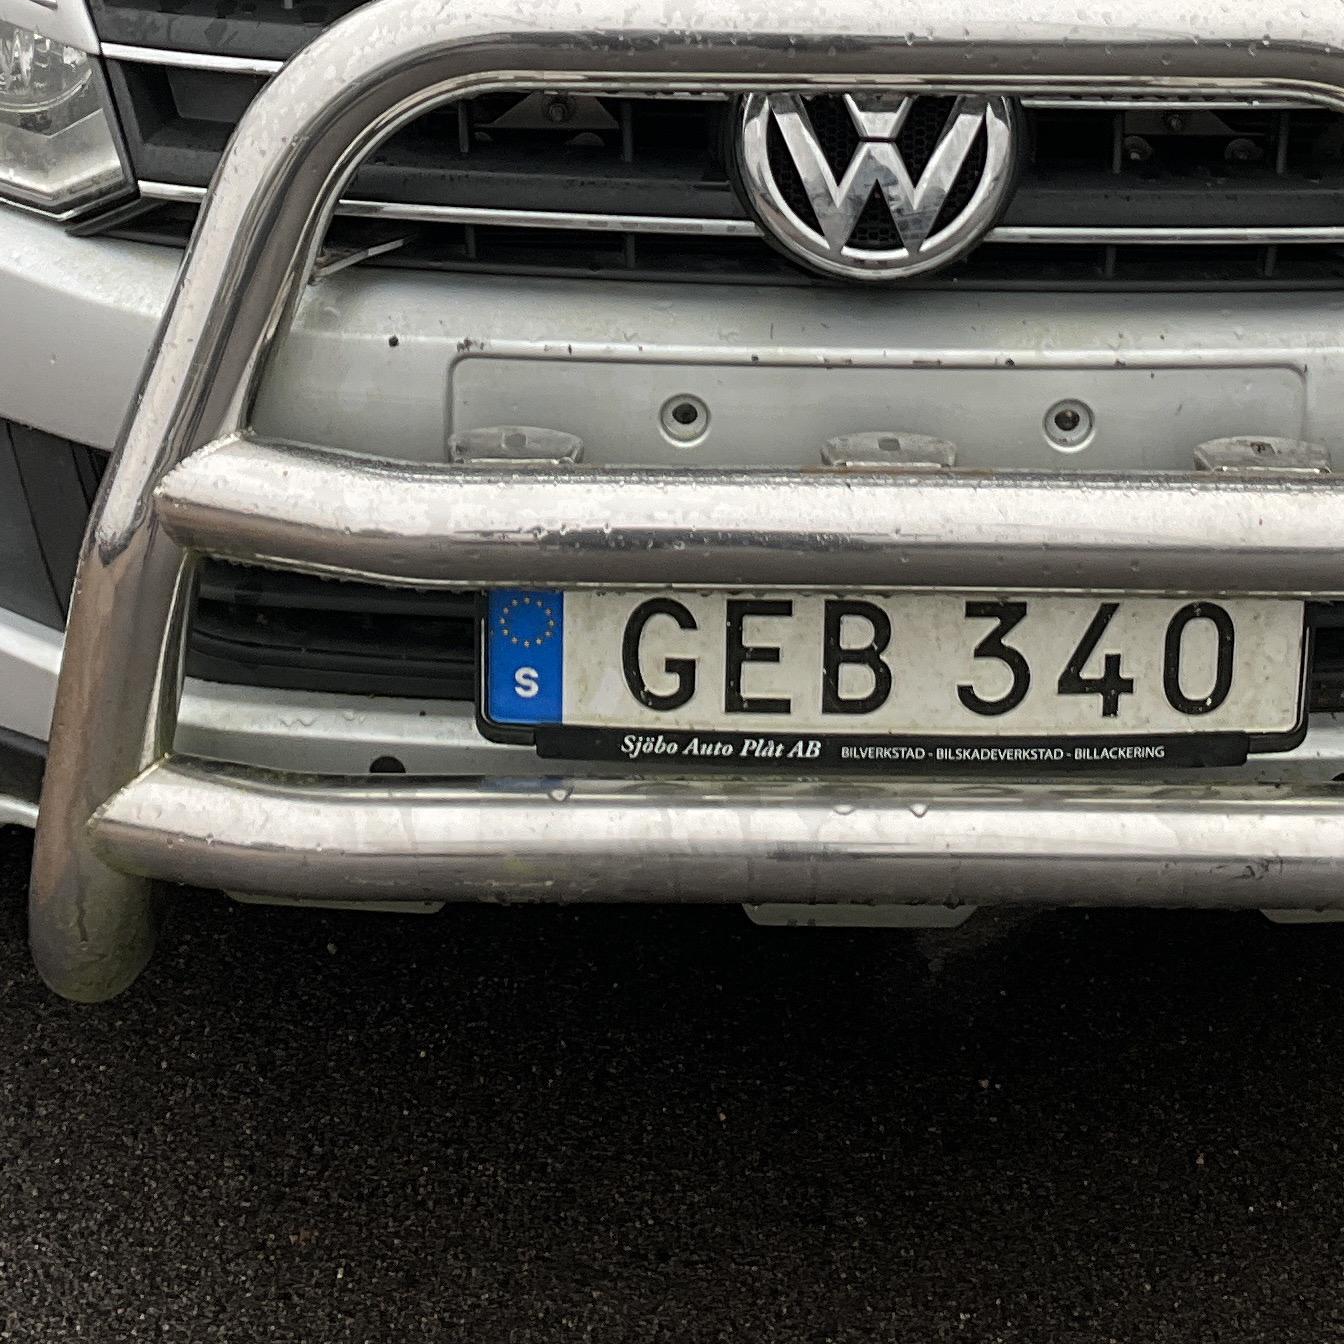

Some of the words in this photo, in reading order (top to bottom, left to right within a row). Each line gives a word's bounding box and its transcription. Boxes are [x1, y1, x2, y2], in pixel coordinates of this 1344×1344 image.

[622, 596, 894, 714] GEB
[956, 600, 1238, 719] 340
[514, 666, 539, 698] S
[621, 734, 678, 759] Sjöbo
[682, 737, 734, 757] Auto
[739, 738, 784, 758] Plåt
[787, 740, 822, 758] AB
[841, 745, 926, 759] BILVERKSTAD
[936, 746, 1064, 761] BILSKADEVERKSTAD
[1074, 745, 1165, 760] BILLACKERING
